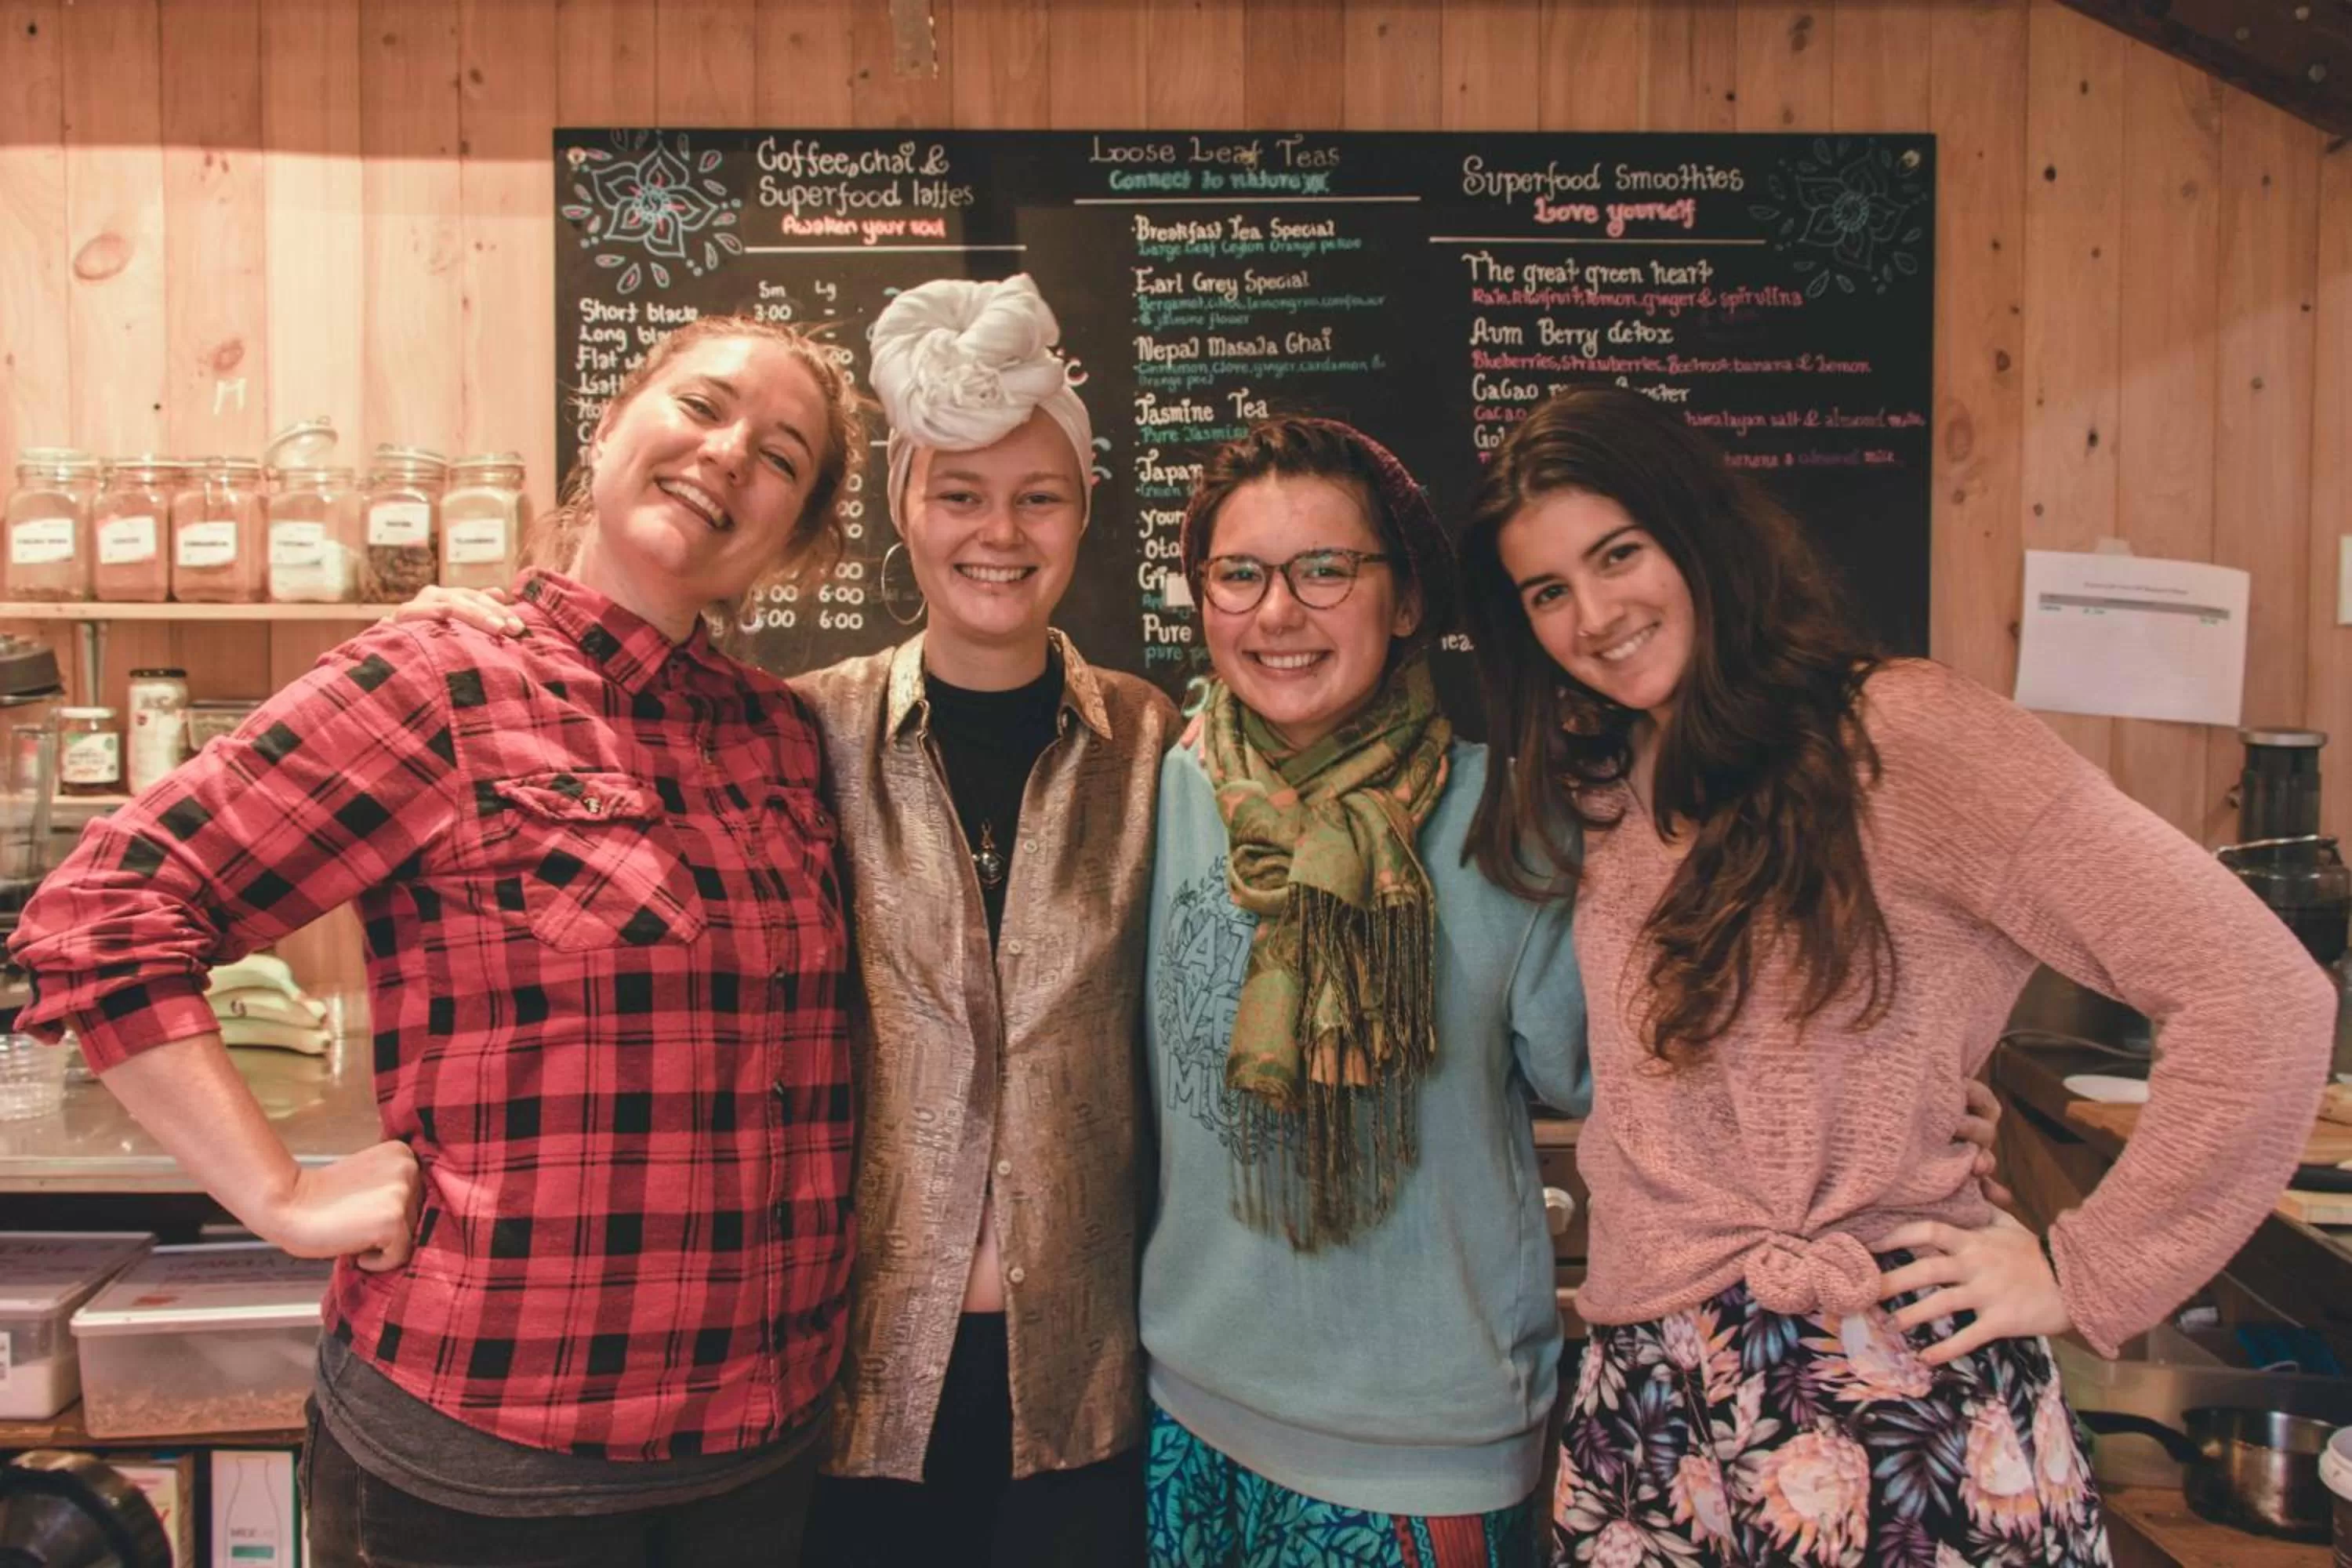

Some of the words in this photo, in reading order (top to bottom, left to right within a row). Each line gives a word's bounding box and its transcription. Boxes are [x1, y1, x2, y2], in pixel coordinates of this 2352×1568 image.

[920, 144, 949, 176] &
[1090, 135, 1176, 163] Loose
[1276, 134, 1341, 168] Teas
[760, 176, 902, 216] Superfood
[913, 180, 975, 209] lattes
[1463, 155, 1601, 205] Superfood
[1615, 163, 1744, 192] Smoothies
[863, 219, 906, 245] your
[1270, 217, 1335, 240] Special
[1534, 198, 1599, 223] Love
[1606, 198, 1696, 237] yourself
[1135, 266, 1183, 295] Earl
[1192, 271, 1238, 302] Grey
[1244, 268, 1311, 295] Special
[1461, 250, 1515, 283] The
[1523, 257, 1580, 293] great
[1584, 265, 1644, 293] green
[1650, 260, 1714, 285] heart
[579, 298, 639, 323] Short
[579, 325, 628, 352] Long
[1135, 336, 1200, 368] Nepal
[1207, 336, 1279, 357] Masala
[1537, 317, 1599, 358] Berry
[1608, 319, 1675, 343] detox
[575, 345, 617, 371] Flat
[1134, 393, 1214, 425] Jasmine
[1227, 387, 1270, 419] Tea
[1142, 613, 1192, 643] Pure
